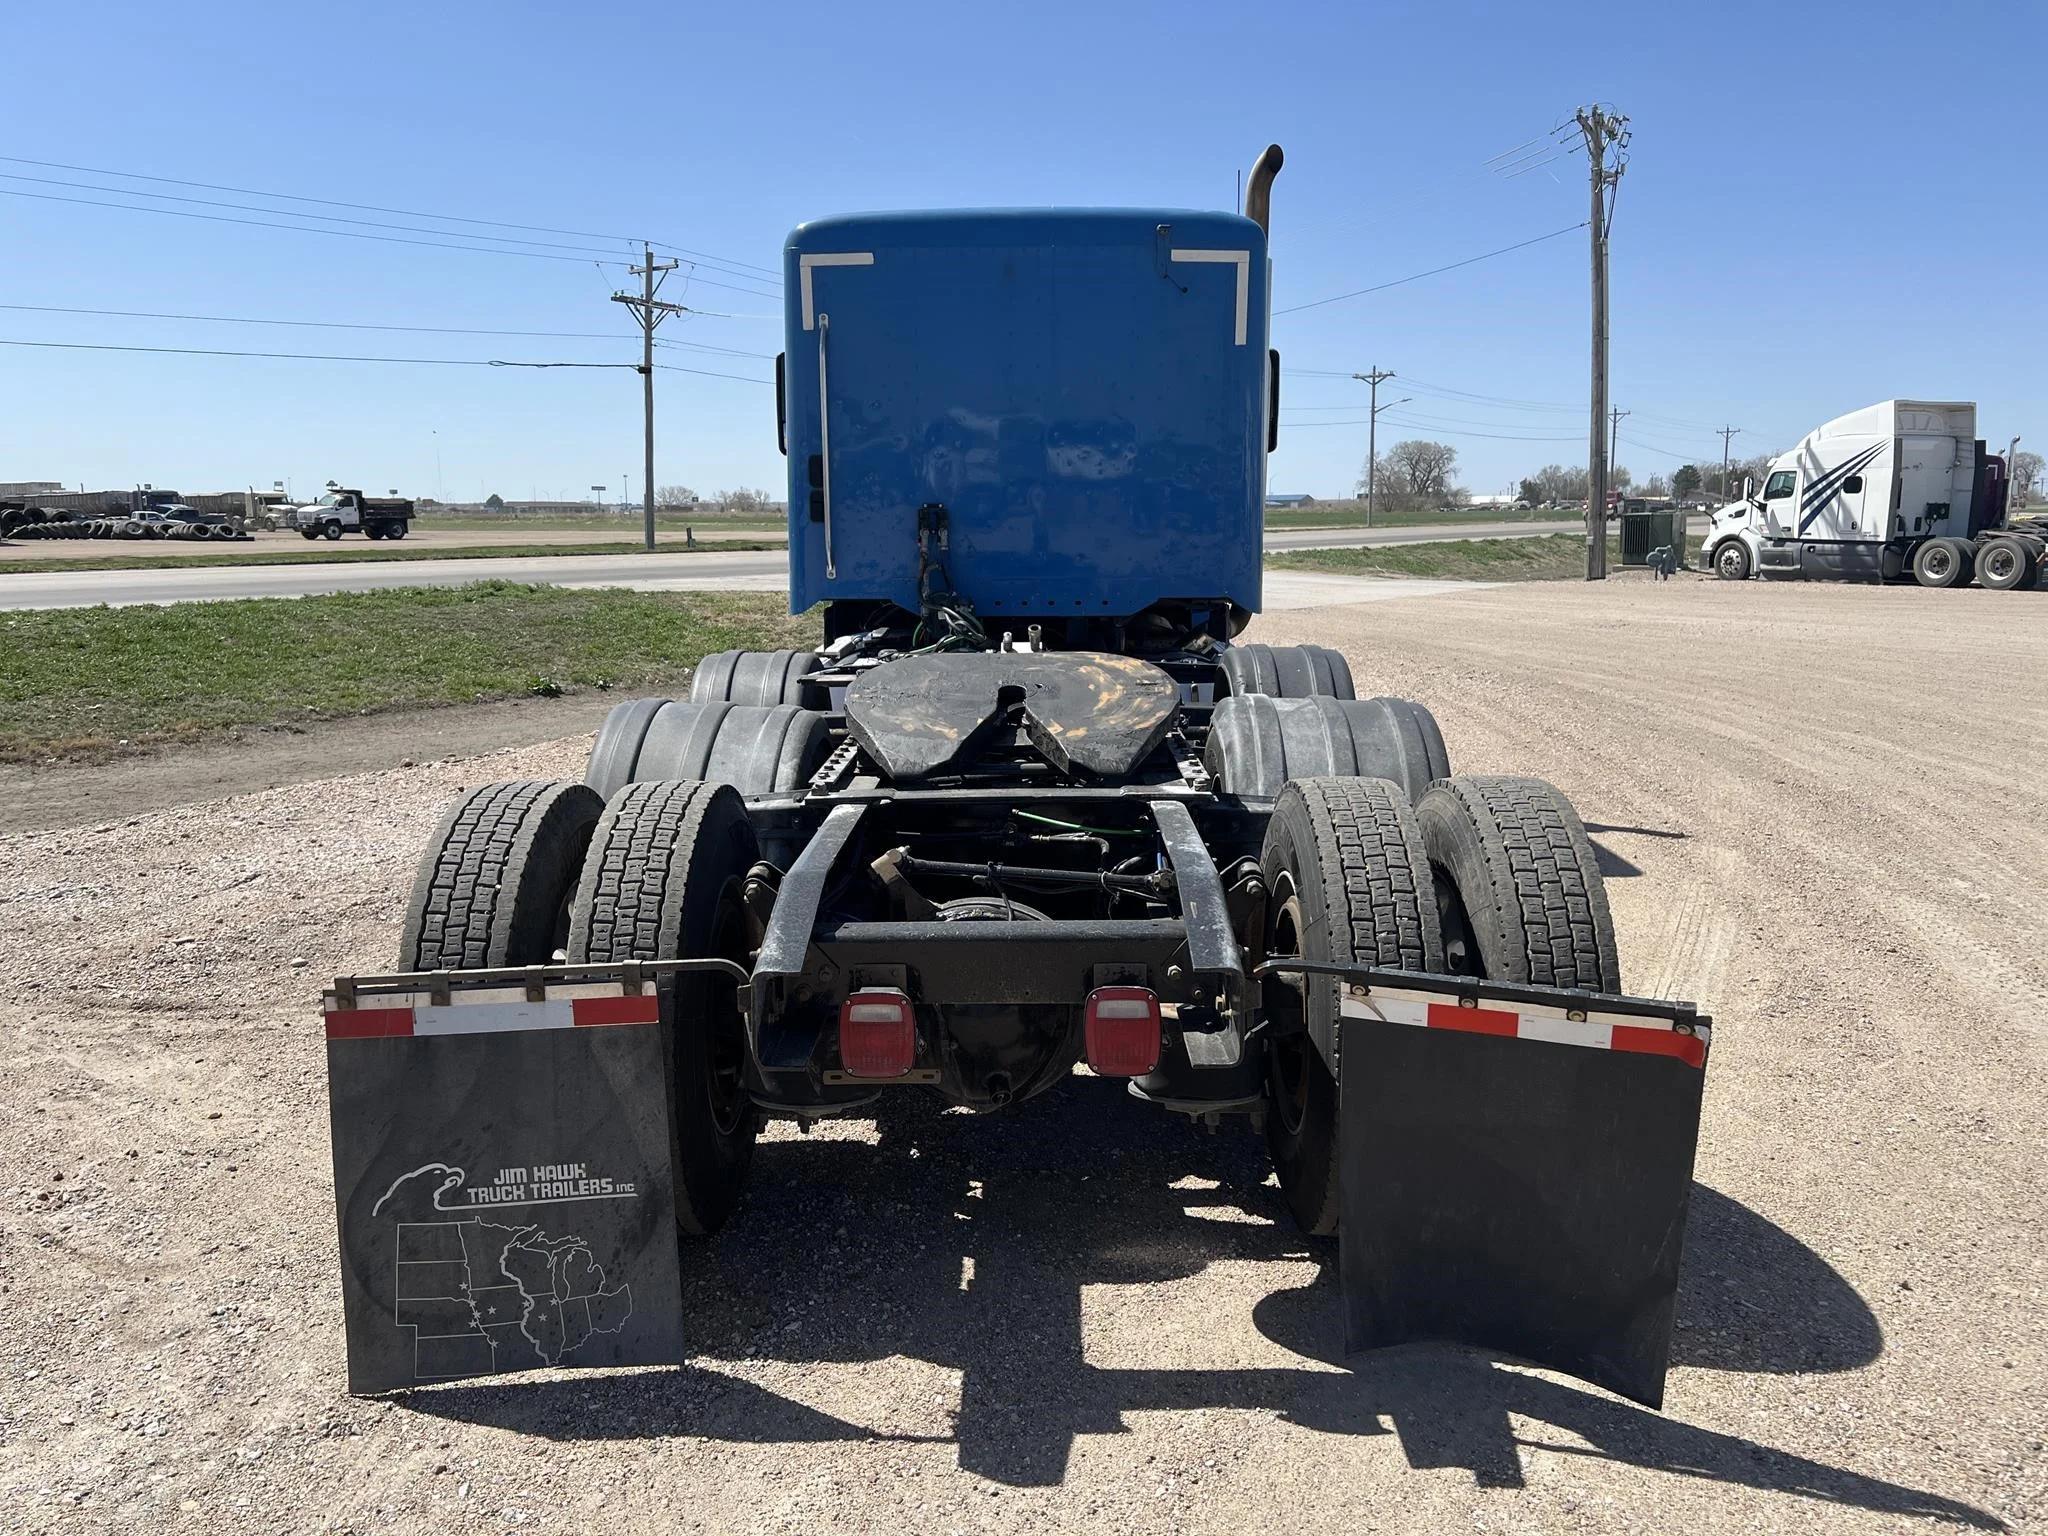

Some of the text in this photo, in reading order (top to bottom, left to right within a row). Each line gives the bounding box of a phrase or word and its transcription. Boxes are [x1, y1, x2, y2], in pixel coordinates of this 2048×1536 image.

[493, 1163, 587, 1185] JIM HAWK
[467, 1184, 525, 1203] TRUCK
[530, 1178, 613, 1199] TRAILERS
